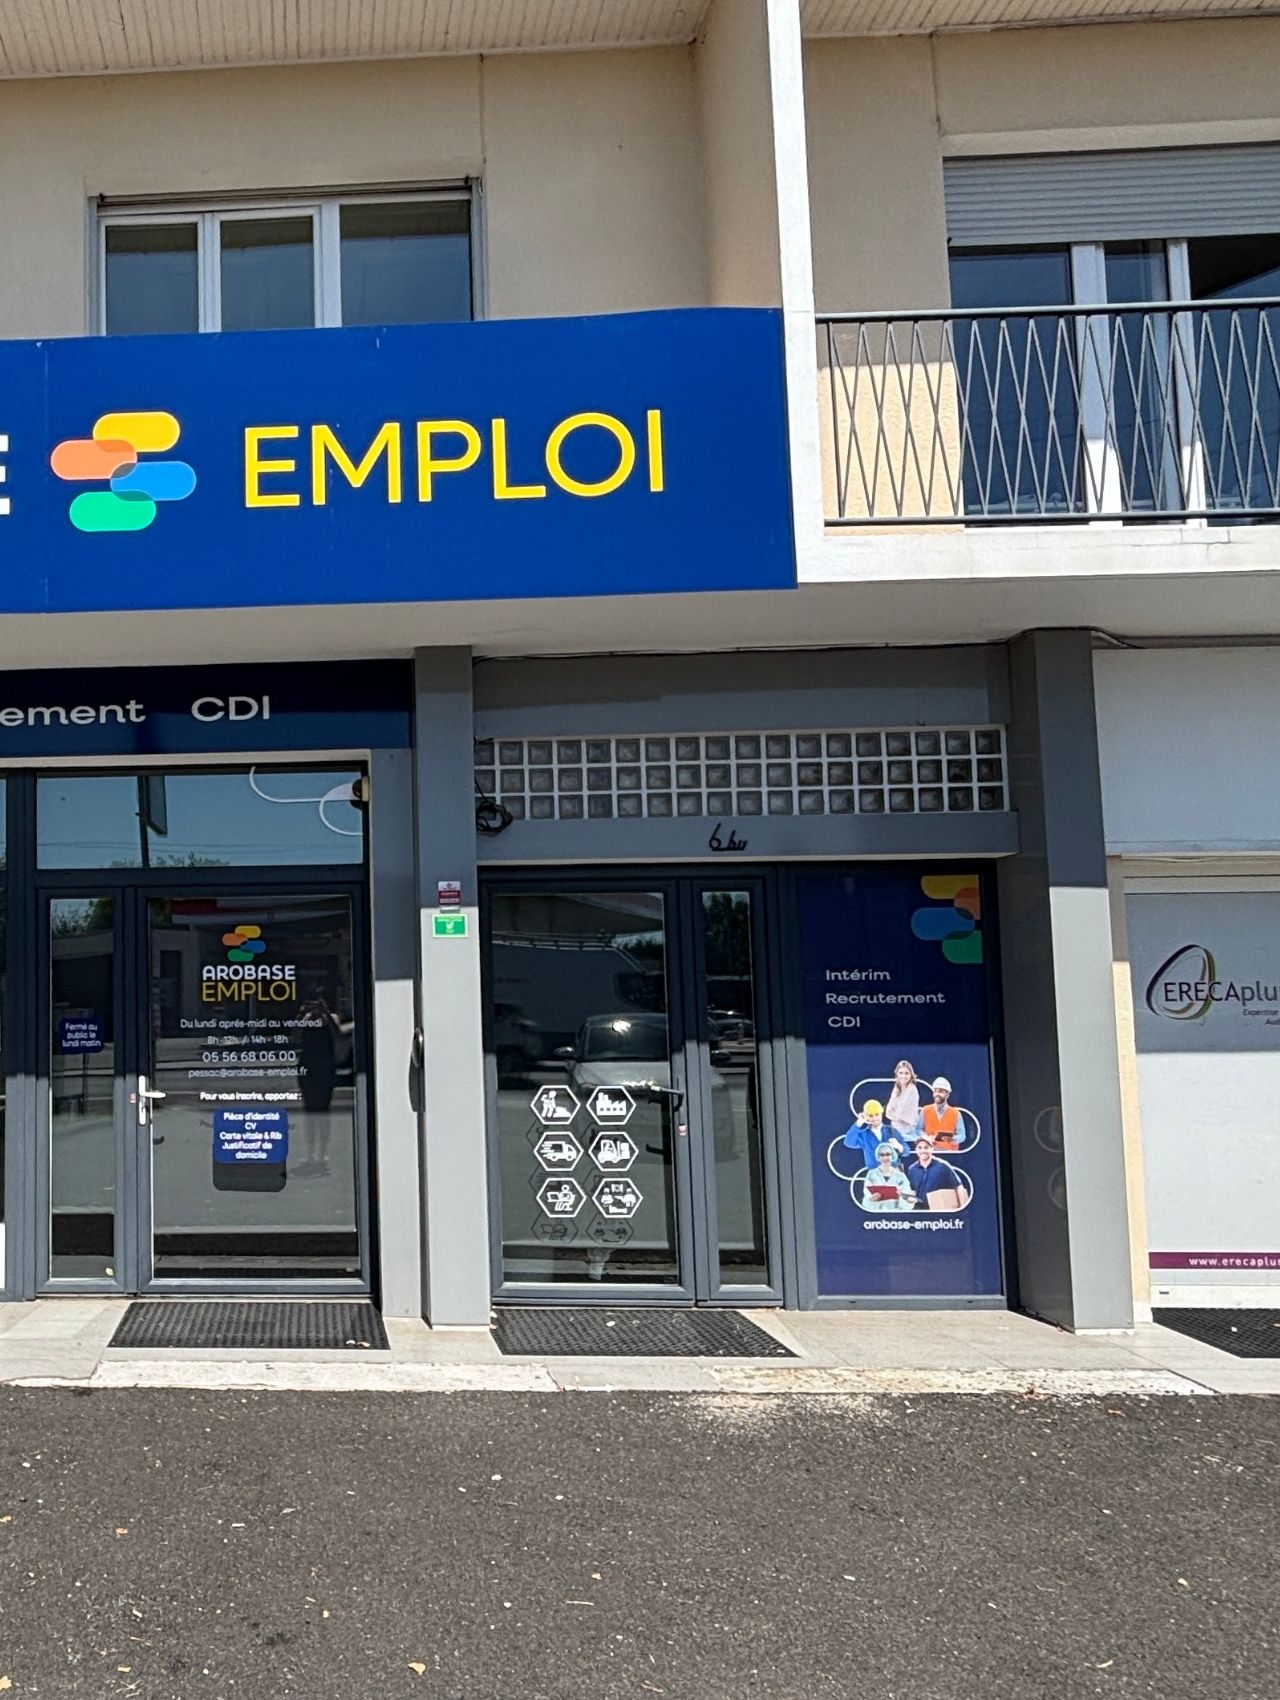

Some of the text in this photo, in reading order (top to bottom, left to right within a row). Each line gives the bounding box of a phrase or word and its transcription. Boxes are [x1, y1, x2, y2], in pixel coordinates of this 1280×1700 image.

[244, 409, 663, 508] EMPLOI
[190, 696, 272, 721] CDI
[202, 964, 297, 981] AROBASE
[825, 968, 891, 981] Intérim
[201, 980, 297, 1002] EMPLOI
[1164, 980, 1280, 1006] ERECAplu
[825, 992, 946, 1004] Recrutement
[180, 1019, 193, 1028] Du
[194, 1019, 217, 1028] lundi
[268, 1020, 280, 1028] au
[282, 1018, 323, 1028] vendredi
[828, 1015, 861, 1028] CDI
[207, 1036, 219, 1045] 8h
[251, 1035, 266, 1044] 14h
[273, 1035, 289, 1044] 18h
[202, 1050, 297, 1062] 05 56 68 06 00
[200, 1092, 217, 1101] Pour
[218, 1092, 235, 1101] vous
[244, 1121, 257, 1131] CV
[863, 1218, 964, 1231] arobase-emploi.fr
